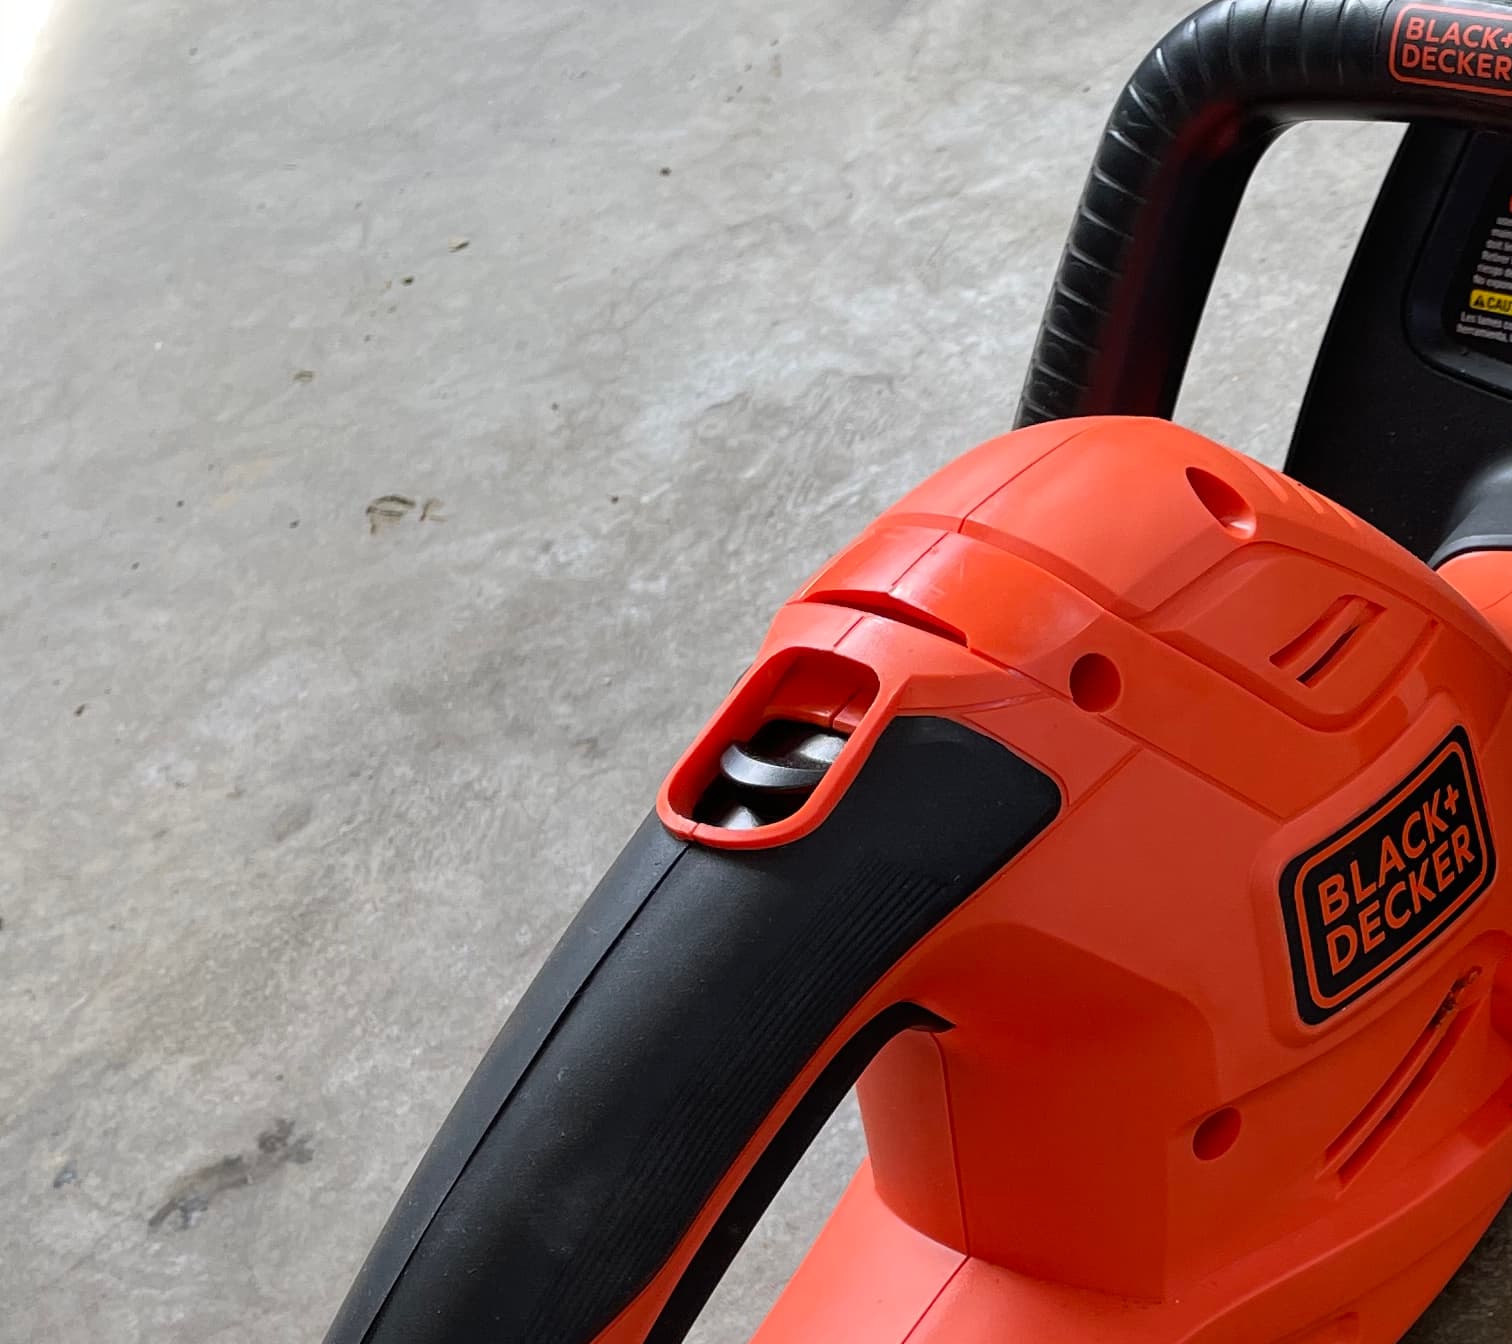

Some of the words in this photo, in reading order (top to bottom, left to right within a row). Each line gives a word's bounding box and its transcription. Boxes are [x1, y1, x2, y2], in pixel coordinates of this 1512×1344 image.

[1401, 43, 1512, 81] DECKER
[1318, 784, 1459, 926] BLACK+
[1326, 824, 1475, 976] DECKER
